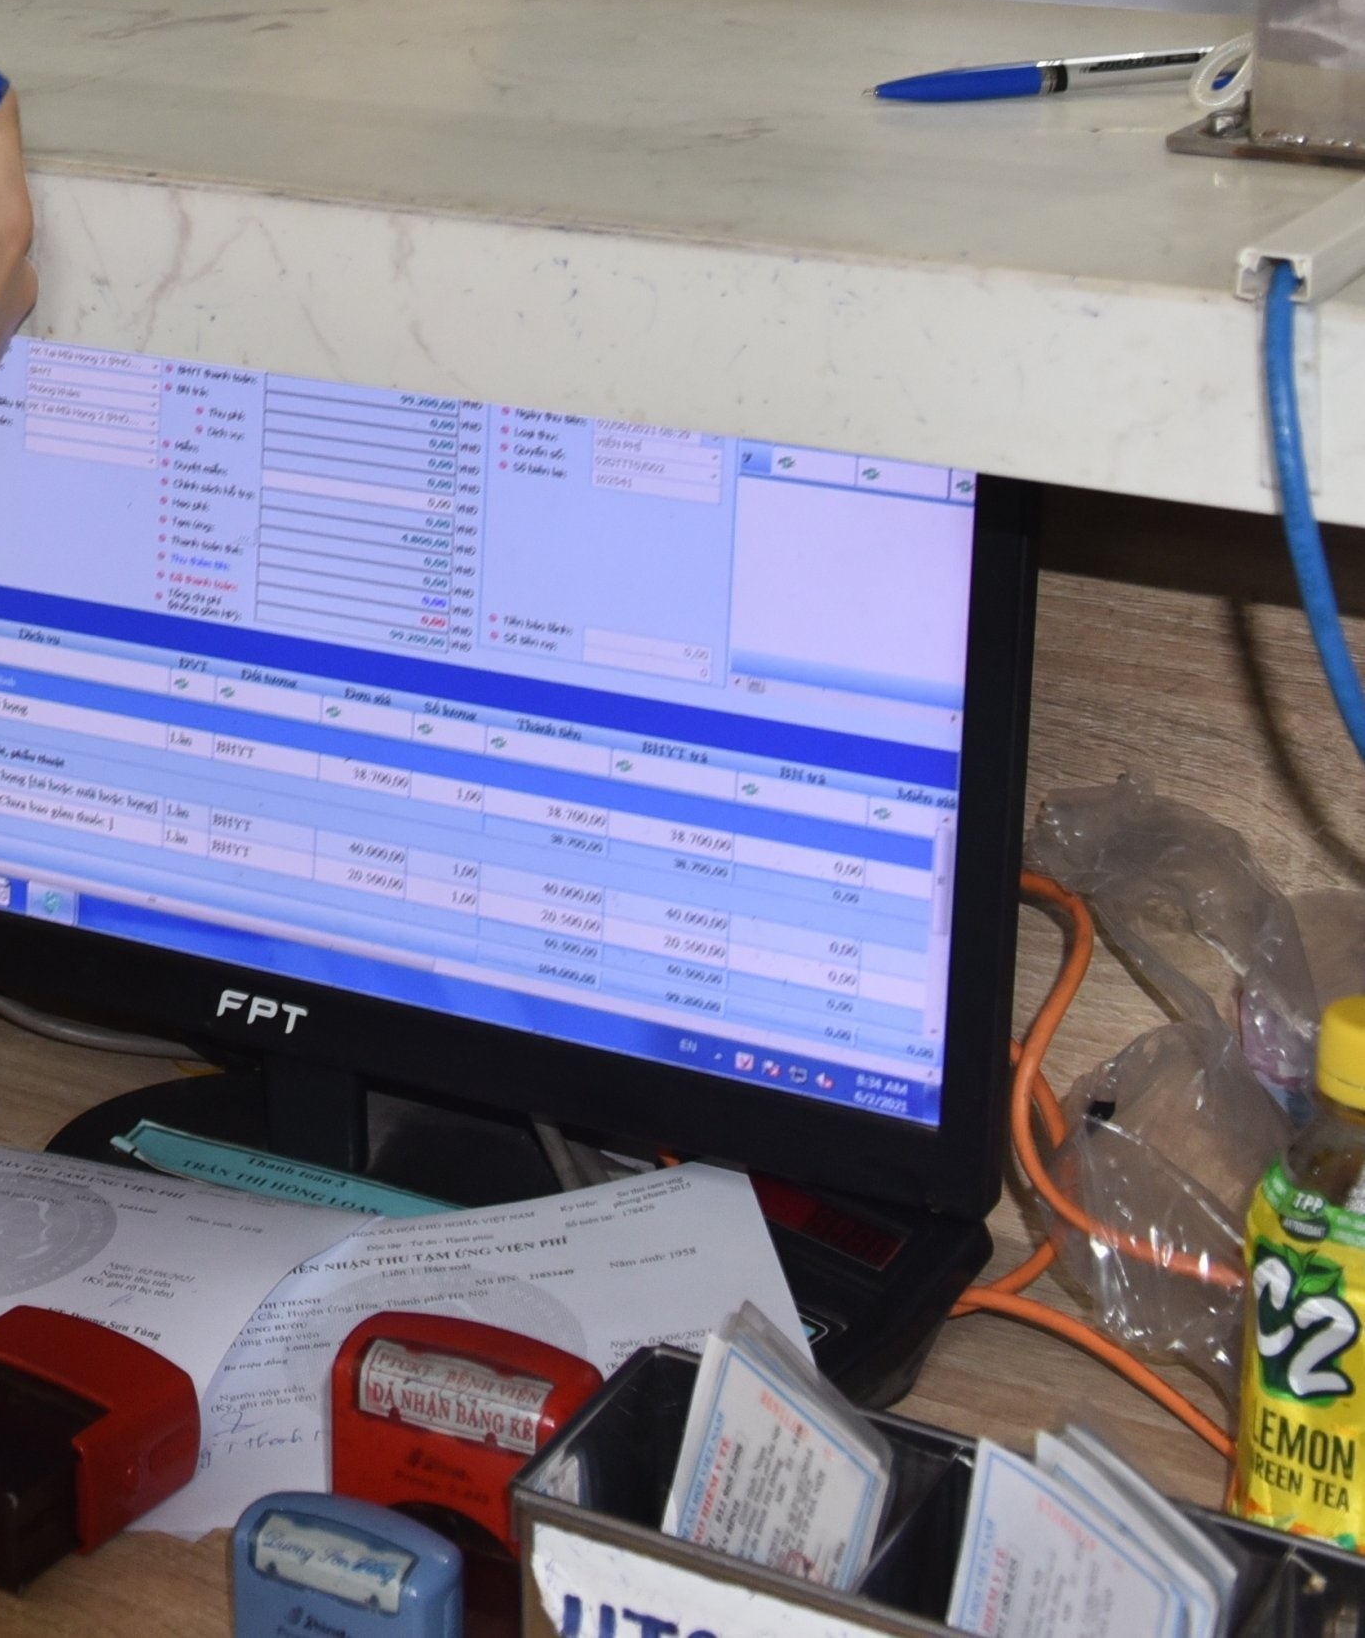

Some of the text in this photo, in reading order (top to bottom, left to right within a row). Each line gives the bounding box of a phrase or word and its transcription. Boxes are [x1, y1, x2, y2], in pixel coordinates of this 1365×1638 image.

[215, 989, 309, 1035] FPT
[246, 1156, 296, 1178] Thanh
[329, 1196, 385, 1216] LOAN
[1293, 1191, 1324, 1213] TPP
[324, 1258, 370, 1273] NHẬN
[373, 1253, 409, 1267] THU
[415, 1249, 451, 1264] TẠM
[494, 1239, 535, 1255] VIỆN
[539, 1234, 569, 1249] PHÍ
[609, 1246, 697, 1269] Năm sinh: 1958
[1252, 1256, 1357, 1397] C2
[219, 1389, 256, 1403] Người
[257, 1387, 280, 1400] nộp
[371, 1380, 534, 1441] ĐÃ NHẬN BẢNG KÊ
[1252, 1403, 1355, 1481] LEMON
[1253, 1453, 1350, 1512] REEN TEA
